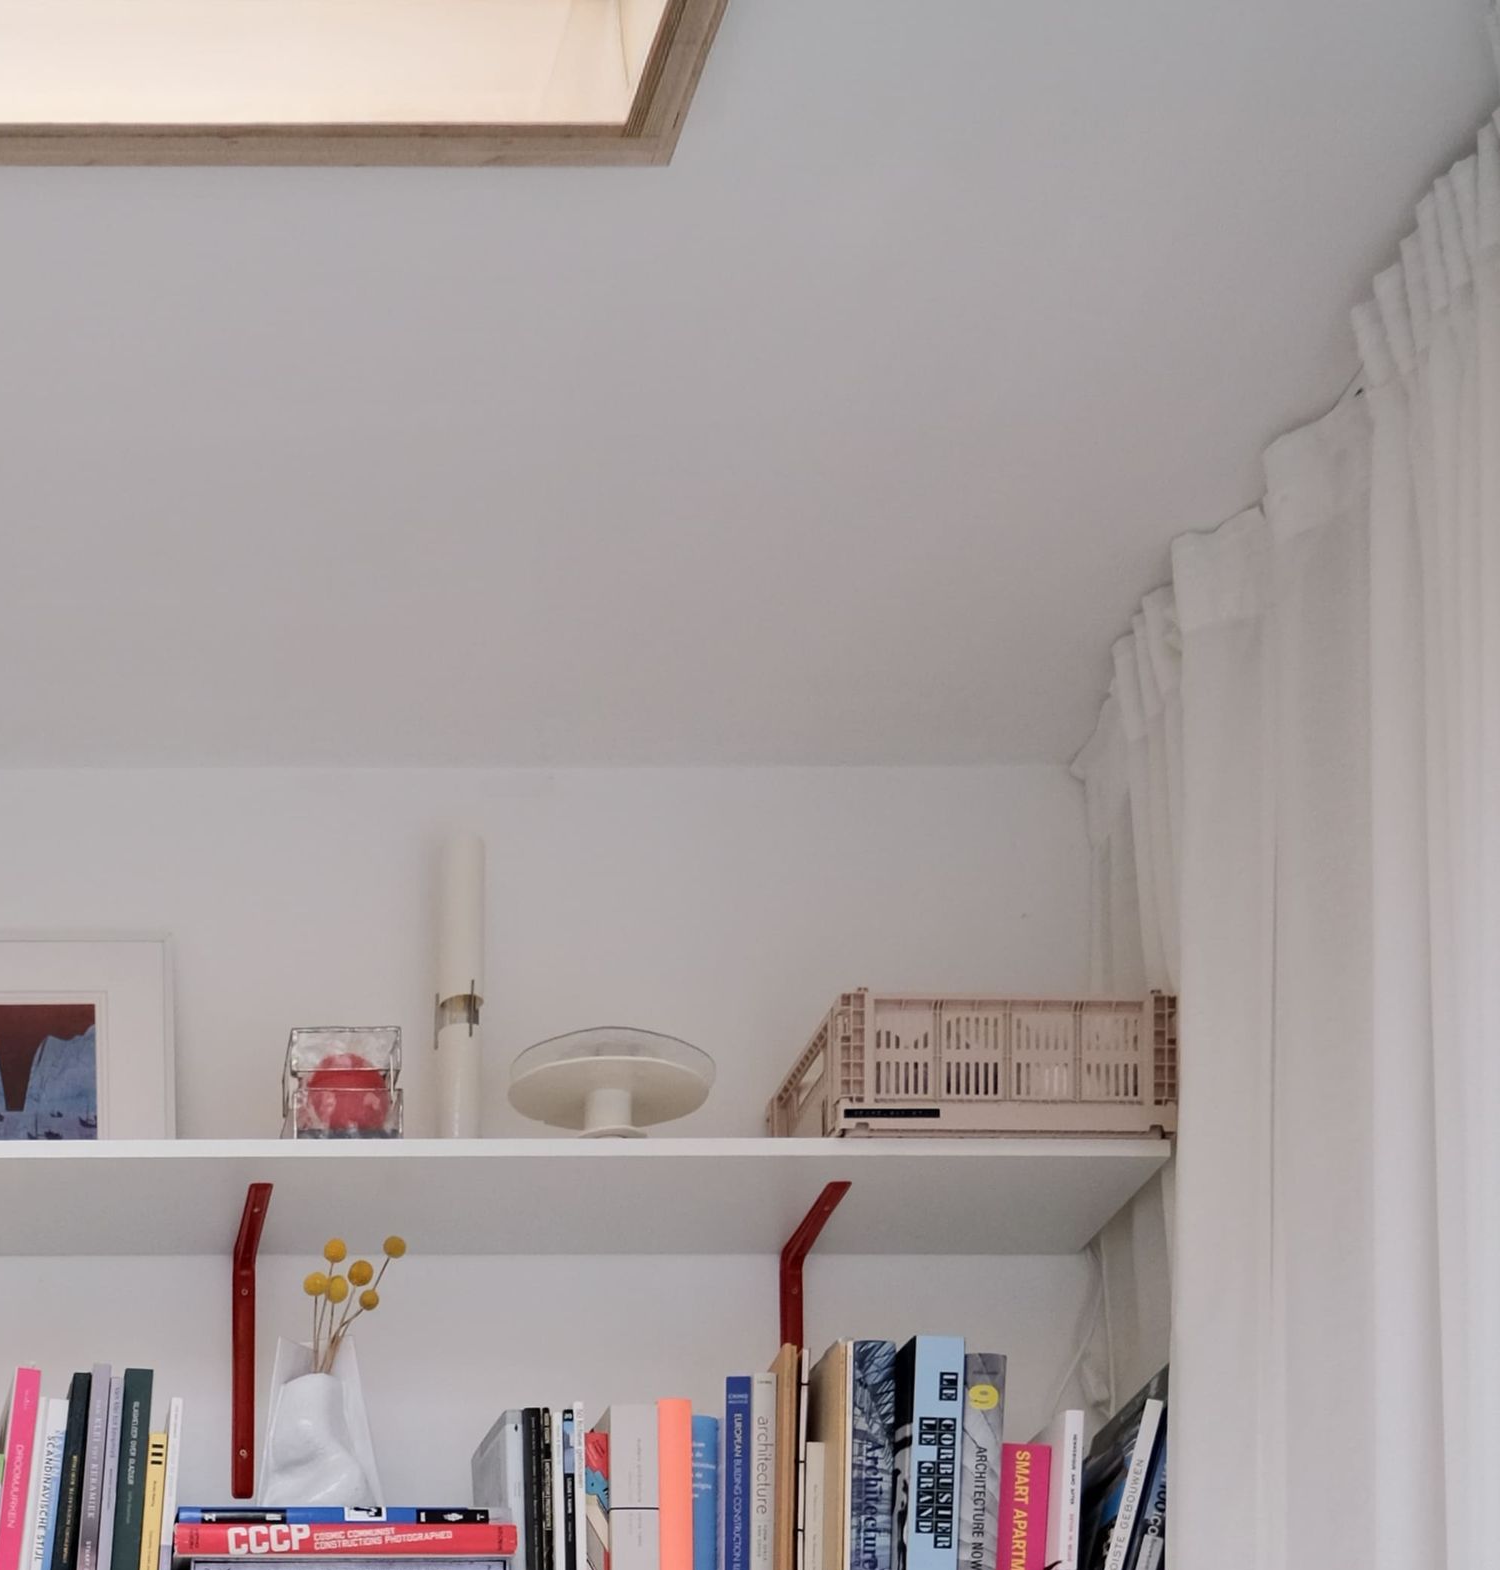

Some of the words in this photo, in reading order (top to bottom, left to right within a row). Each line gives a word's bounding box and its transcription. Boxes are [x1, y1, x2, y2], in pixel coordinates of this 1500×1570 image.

[941, 1374, 958, 1400] LE
[733, 1413, 743, 1457] EUROPEAN
[756, 1415, 774, 1514] architecture
[920, 1419, 936, 1445] LE
[733, 1458, 743, 1494] BUILDING
[862, 1439, 886, 1570] Architecture
[917, 1462, 934, 1533] GRAND
[935, 1418, 956, 1548] CORBUSIER
[971, 1446, 988, 1538] ARCHITECTURE
[1013, 1450, 1031, 1503] SMART
[1119, 1458, 1146, 1530] GEBOUWEN
[227, 1524, 311, 1555] CCCP
[732, 1496, 743, 1561] CONSTRUCTION
